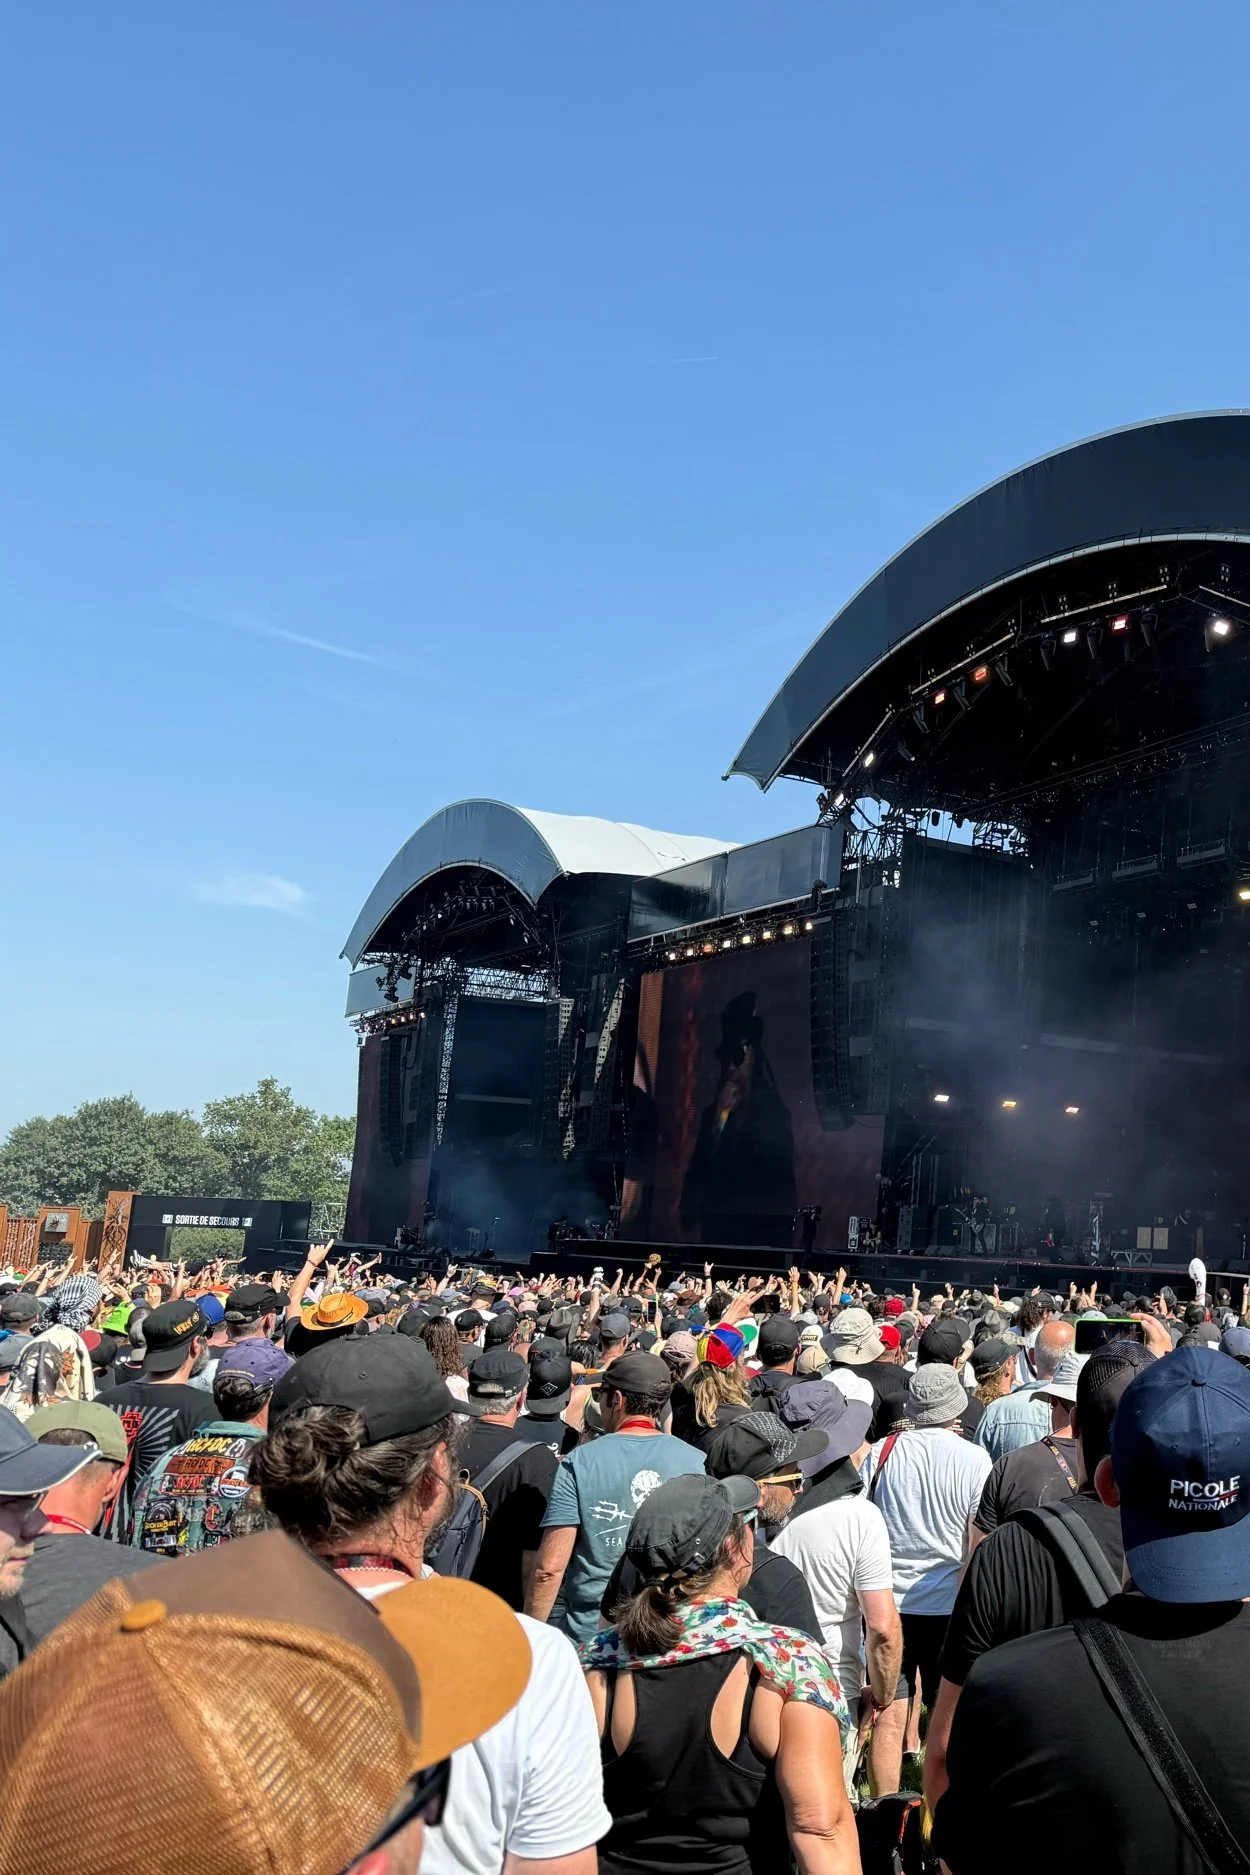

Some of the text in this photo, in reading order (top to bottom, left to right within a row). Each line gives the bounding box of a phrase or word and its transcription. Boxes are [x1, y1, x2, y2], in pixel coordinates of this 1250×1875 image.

[175, 1214, 240, 1227] SORTIE DE SECOURS
[186, 1437, 233, 1453] AC/DC
[1170, 1475, 1240, 1497] PICOLE
[1168, 1494, 1238, 1511] NATIONALE
[605, 1537, 623, 1547] SEA
